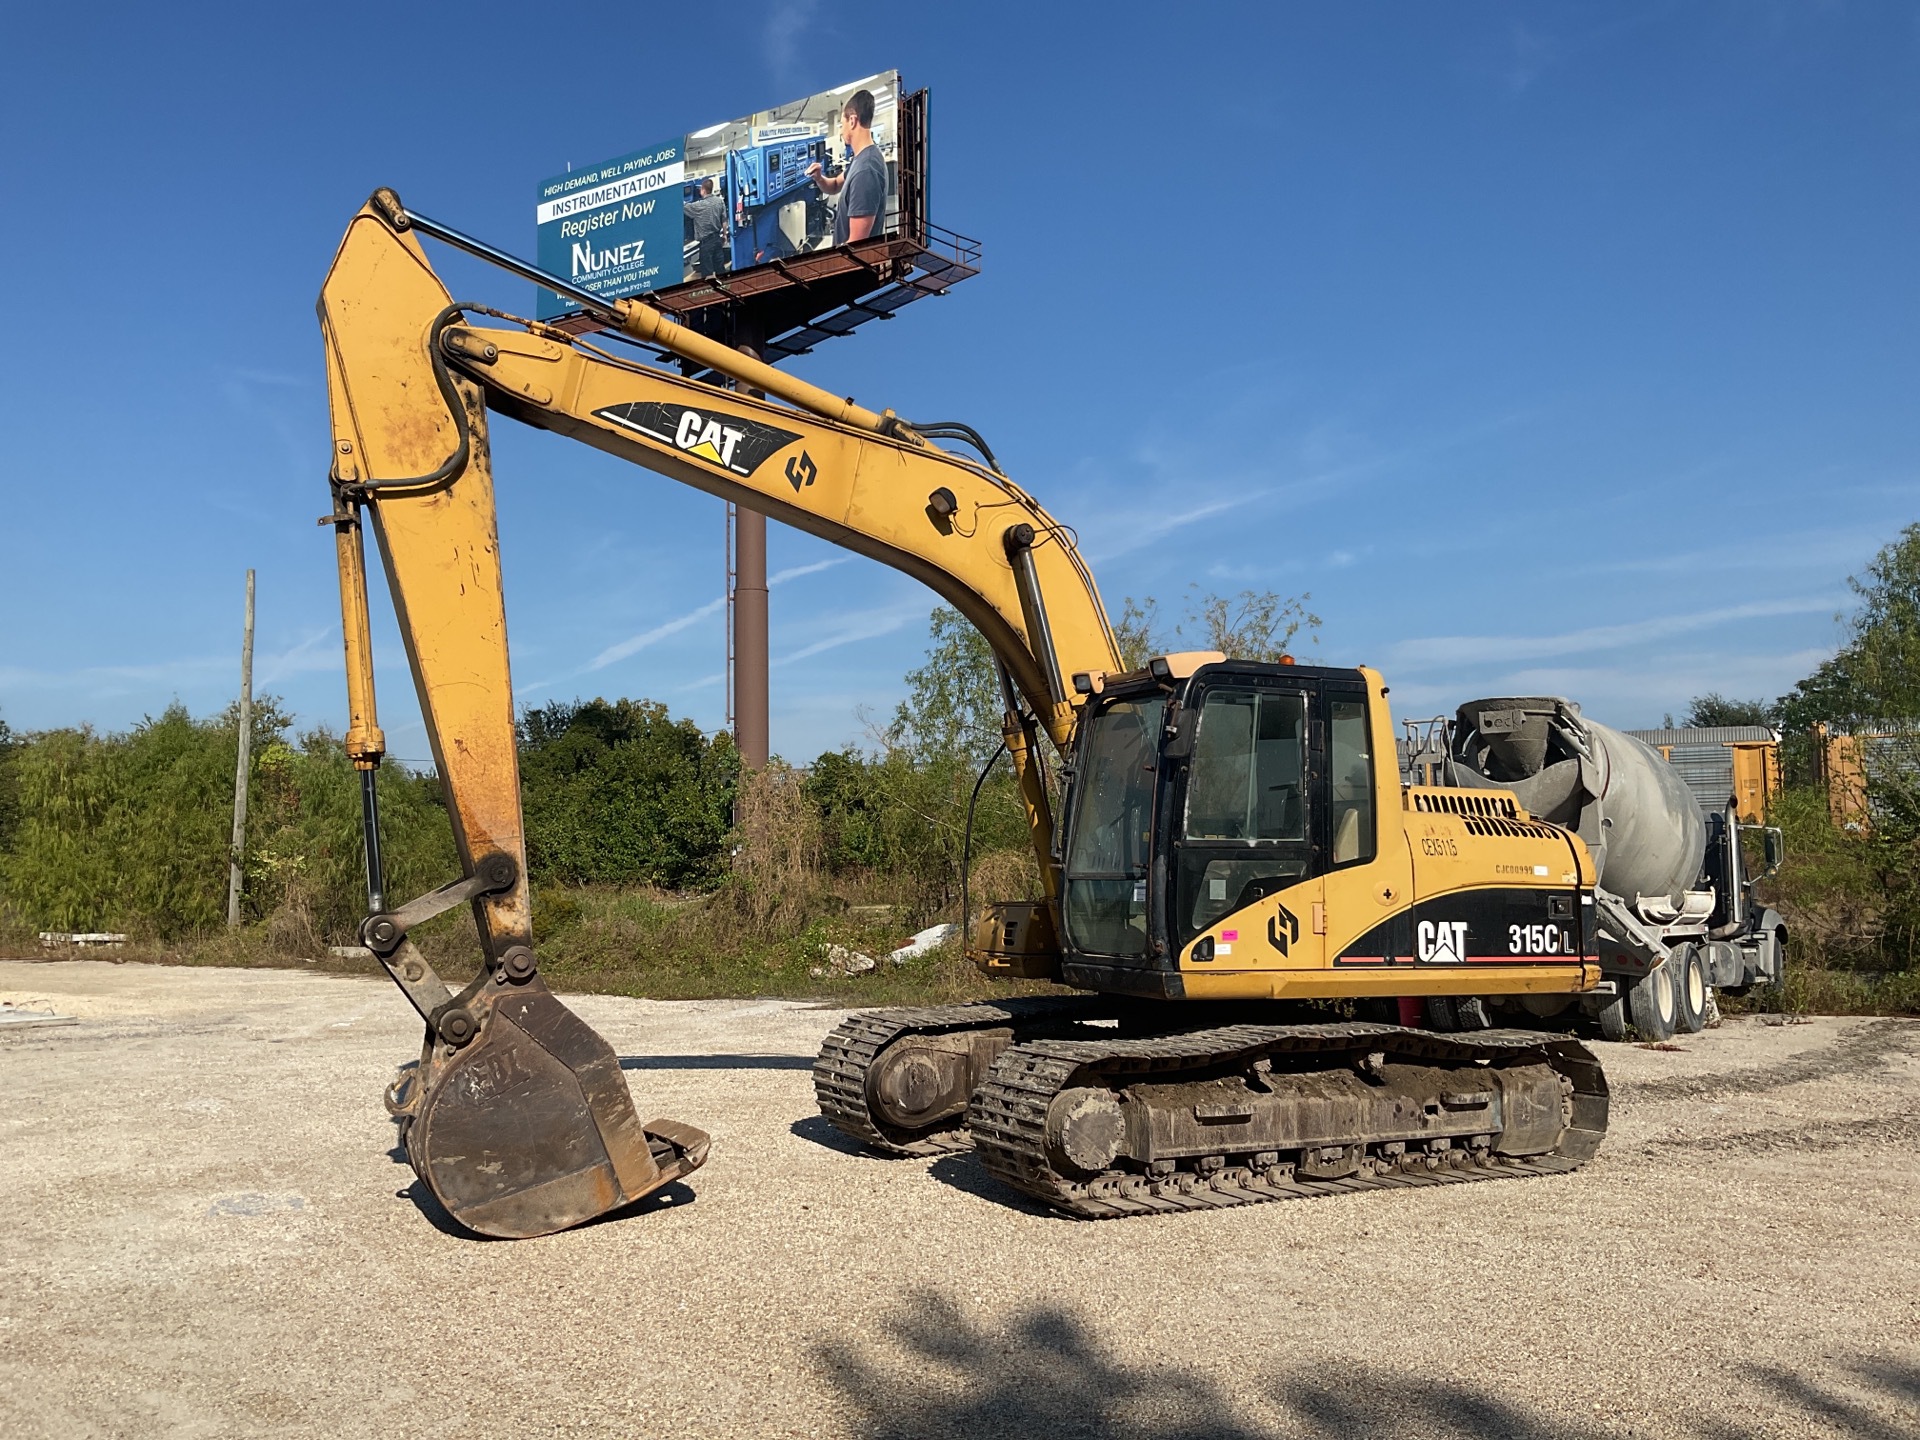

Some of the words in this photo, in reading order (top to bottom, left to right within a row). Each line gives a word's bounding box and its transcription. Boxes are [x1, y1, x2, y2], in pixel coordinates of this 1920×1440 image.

[544, 183, 563, 197] HIGH
[564, 173, 599, 191] DEMAND,
[600, 165, 621, 180] WELL
[623, 156, 652, 173] PAYING
[654, 148, 676, 163] JOBS
[552, 171, 666, 217] INSTRUMENTATION
[560, 210, 619, 239] Register
[621, 199, 656, 222] Now
[571, 268, 611, 285] COMMUNITY
[612, 259, 645, 274] COLLEGE
[603, 276, 622, 288] THAN
[623, 272, 637, 283] YOU
[638, 266, 660, 279] THINK
[675, 410, 742, 467] CAT
[1483, 711, 1520, 730] beck
[1421, 838, 1458, 856] CEX5115
[1417, 920, 1468, 963] CAT
[1508, 923, 1558, 954] 315C
